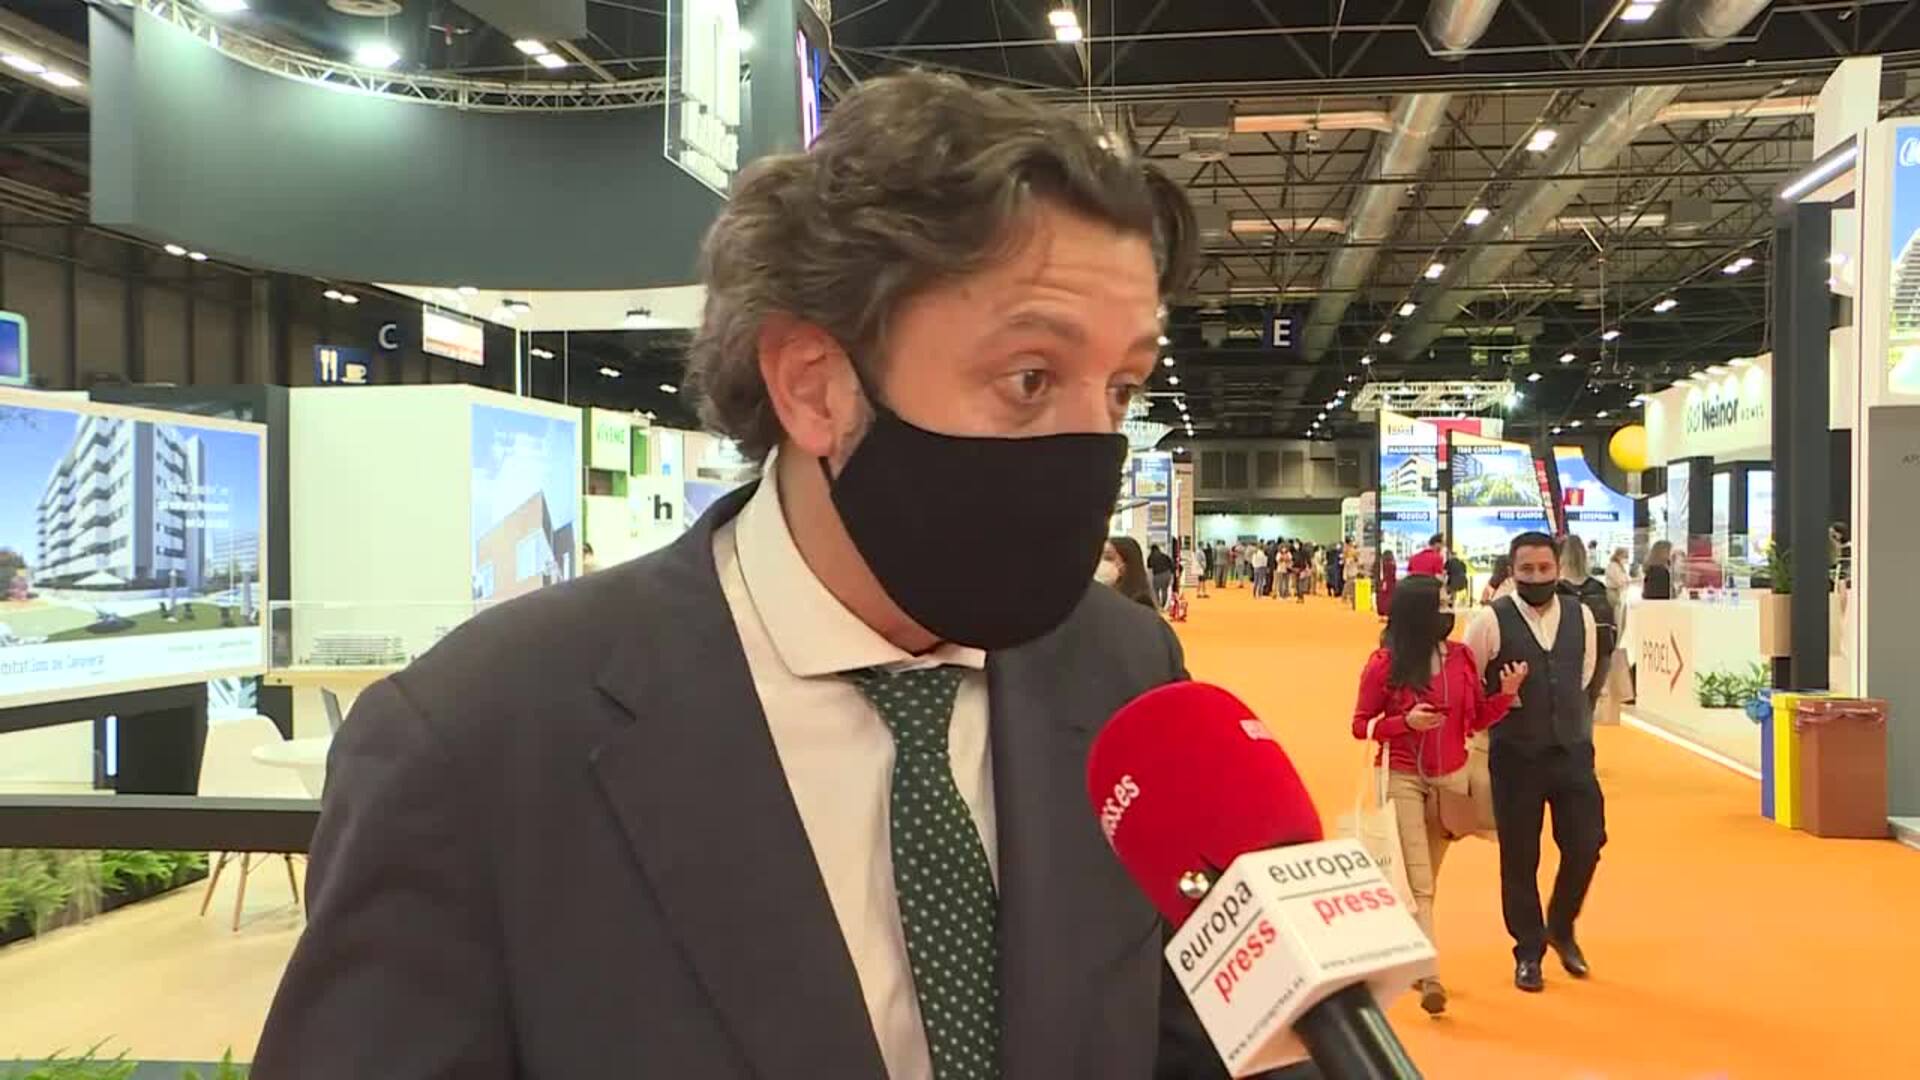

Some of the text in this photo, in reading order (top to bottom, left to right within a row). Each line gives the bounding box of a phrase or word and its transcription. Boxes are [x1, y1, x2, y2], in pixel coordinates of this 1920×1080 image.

[379, 323, 398, 349] C
[1273, 318, 1291, 347] E
[1702, 394, 1739, 431] Neinor
[1642, 640, 1671, 675] PROEL
[1268, 847, 1371, 885] europa
[1312, 886, 1397, 926] press
[1178, 879, 1254, 973] europa
[1213, 917, 1278, 1004] press
